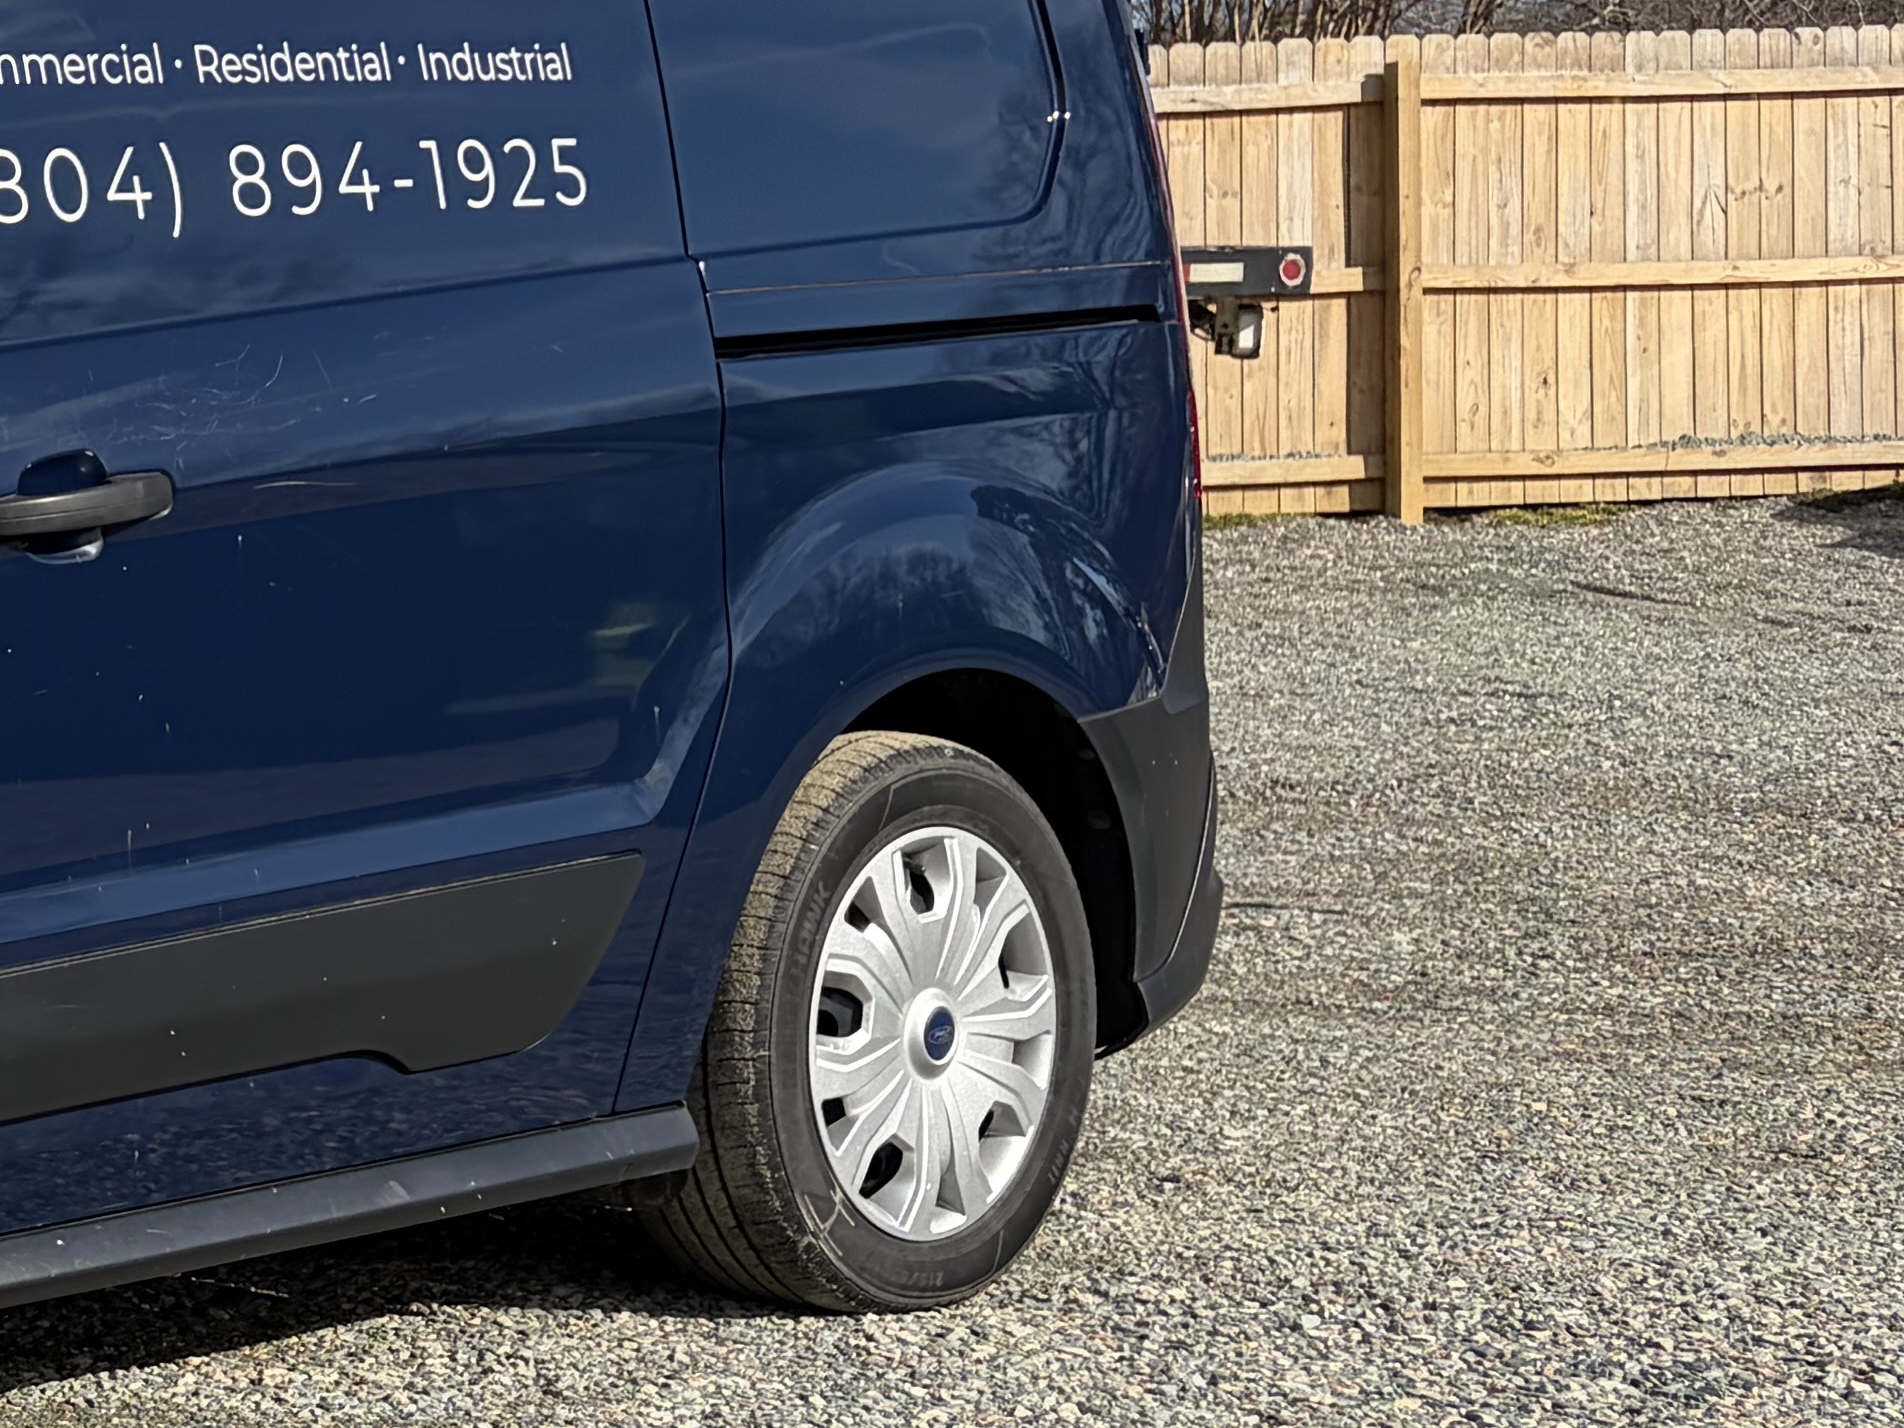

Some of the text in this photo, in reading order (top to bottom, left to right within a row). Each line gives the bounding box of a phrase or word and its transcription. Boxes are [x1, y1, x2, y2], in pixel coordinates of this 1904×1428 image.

[193, 41, 392, 84] Residential
[417, 41, 572, 82] Industrial
[229, 137, 587, 217] 894-1925
